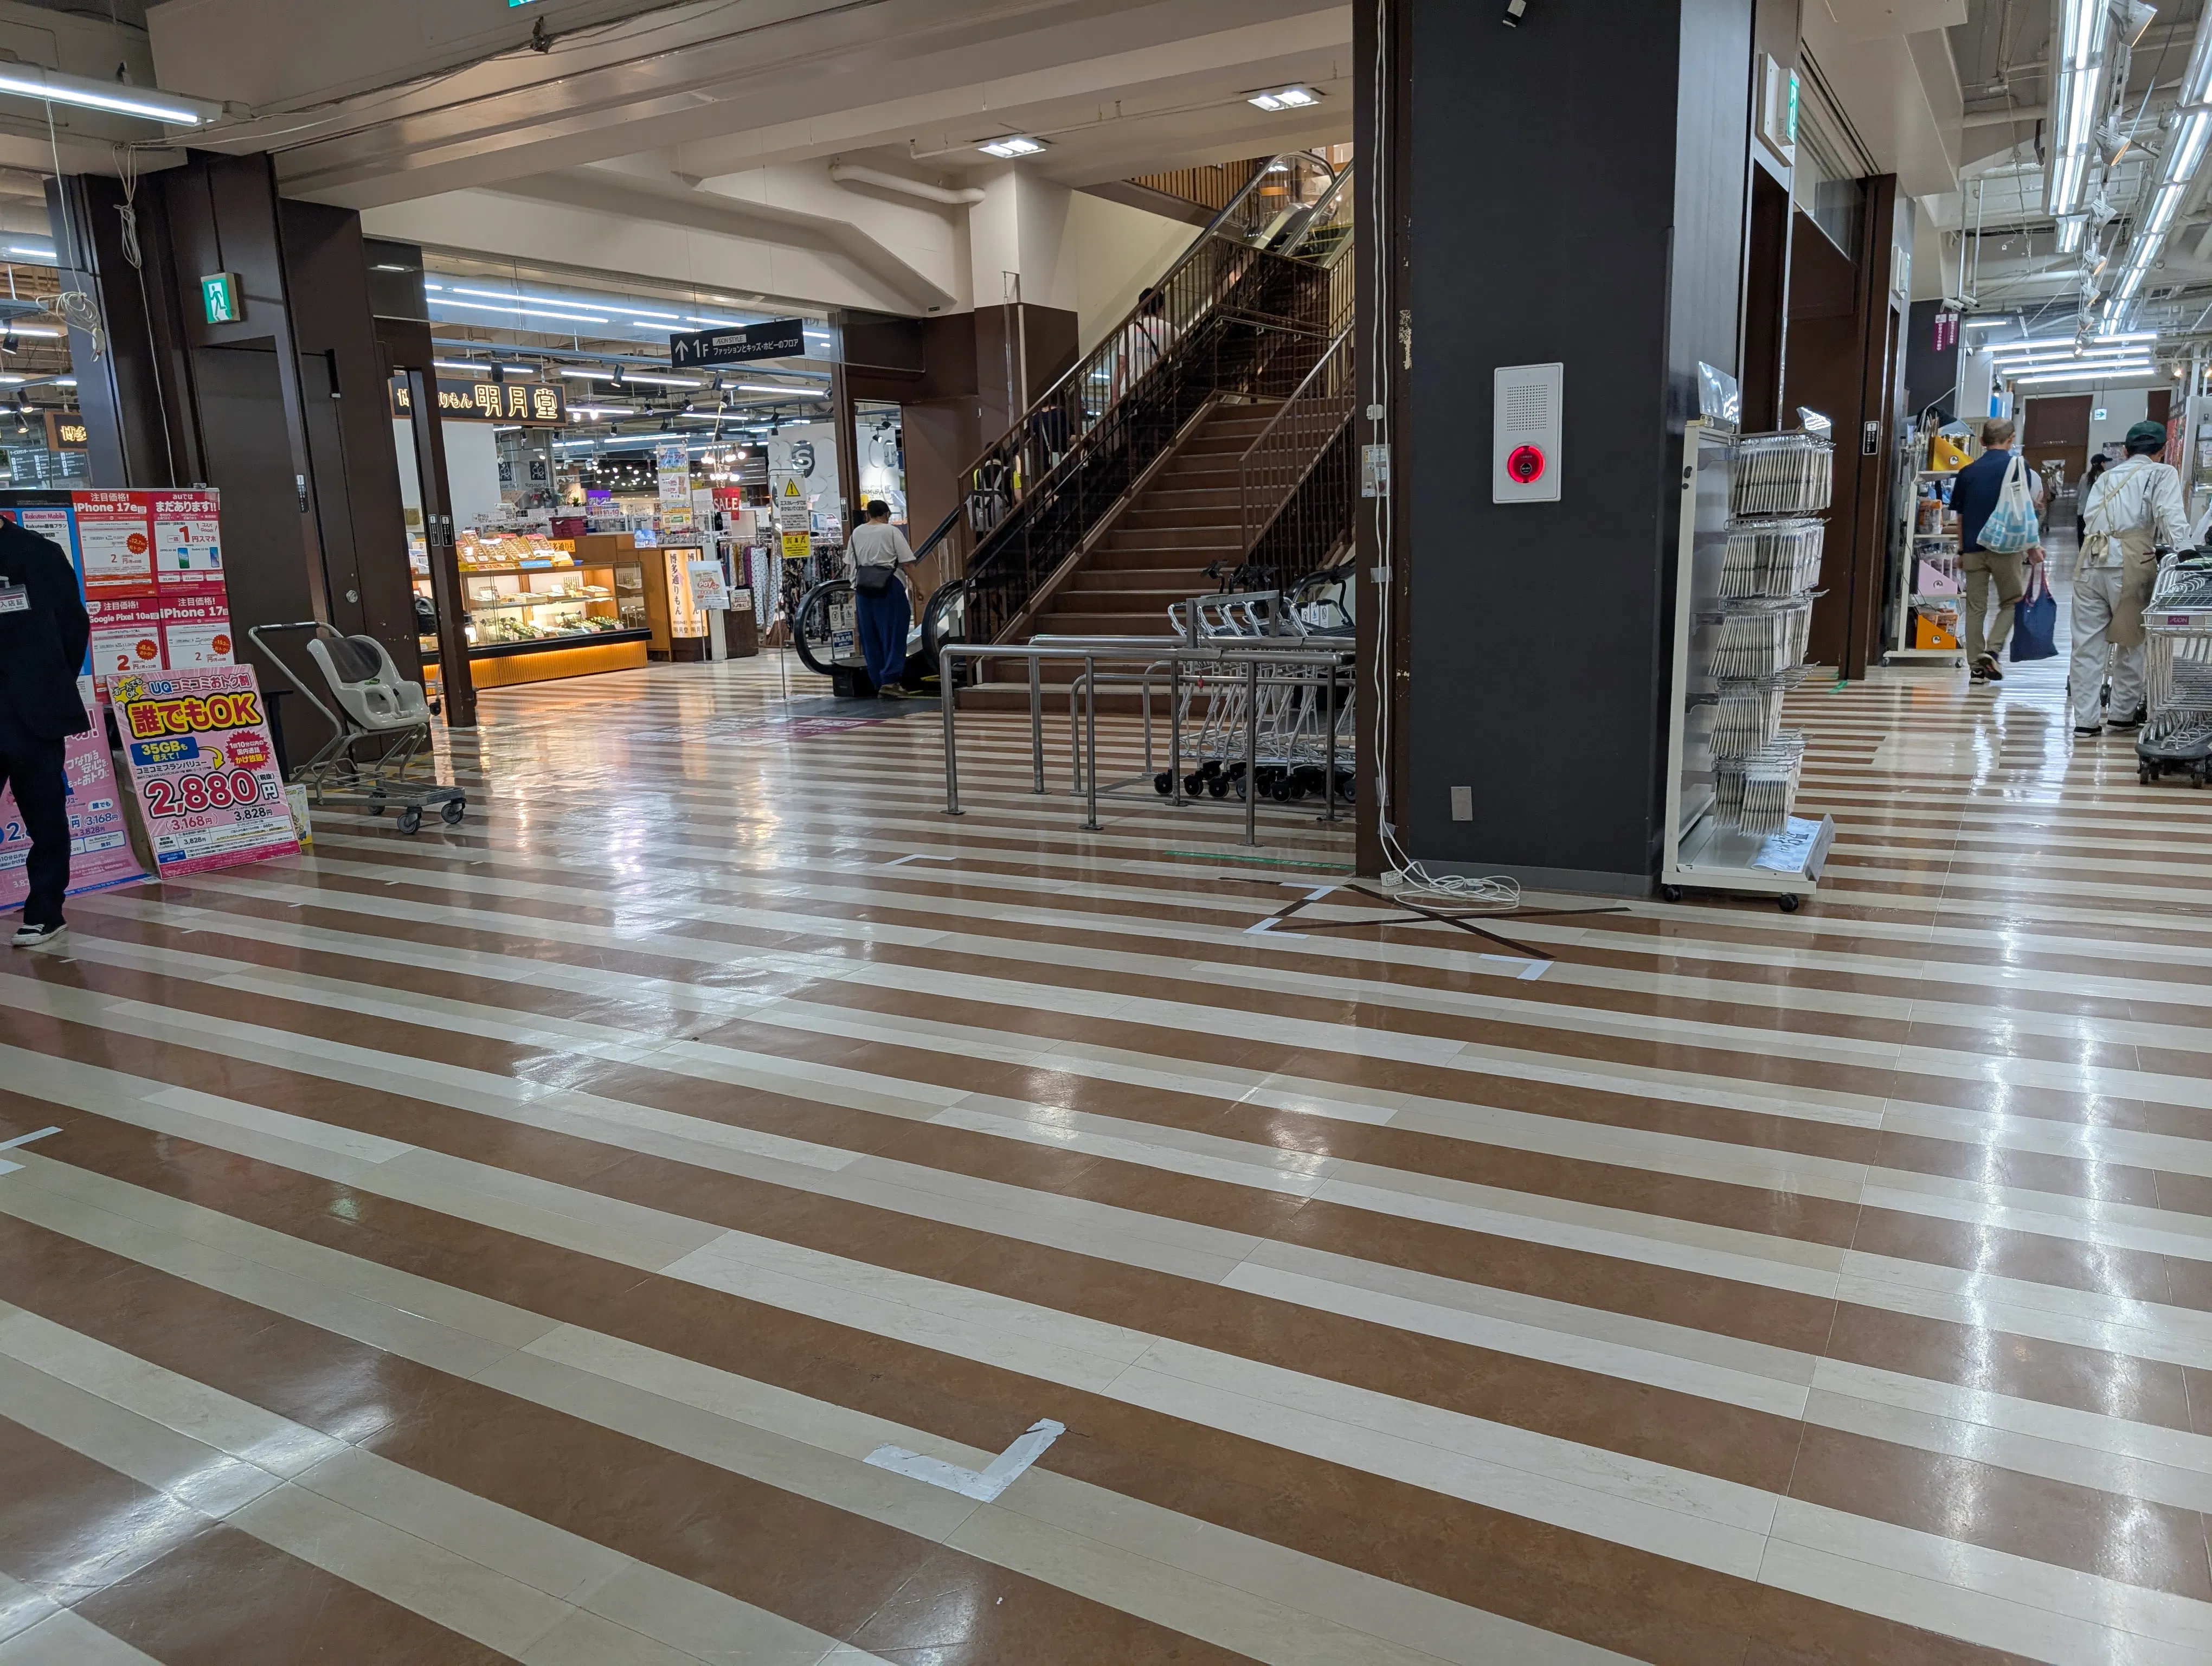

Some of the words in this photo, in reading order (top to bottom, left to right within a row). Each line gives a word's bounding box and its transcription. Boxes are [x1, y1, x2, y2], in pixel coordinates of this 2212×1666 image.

[693, 339, 709, 357] 1F
[713, 338, 799, 356] ファッションとキッズ・ホビーのフロア
[474, 385, 558, 419] 明月堂
[90, 492, 130, 502] 注目価格!
[73, 502, 114, 512] iPhone
[117, 502, 138, 512] 17e
[155, 501, 217, 512] まだあります!!
[713, 497, 739, 511] SALE
[179, 526, 190, 543] 1
[111, 554, 118, 563] 2
[670, 553, 682, 616] 博多通りもん
[104, 600, 139, 611] 注目価格!
[178, 597, 215, 607] 注目価格!
[89, 614, 115, 624] Google
[115, 612, 134, 621] Pixel
[159, 607, 205, 619] iPhone
[209, 606, 223, 617] 17
[117, 655, 131, 671] 2
[195, 652, 202, 661] 2
[149, 674, 252, 695] UQコミコミおトク割
[126, 690, 139, 699] OK
[129, 695, 260, 735] 誰でもOK
[141, 741, 188, 755] 35GBも
[235, 753, 266, 764] かけ放題!
[136, 760, 208, 774] コミコミプランバリュー
[234, 807, 273, 821] 3,828円
[183, 836, 207, 845] 3,828円
